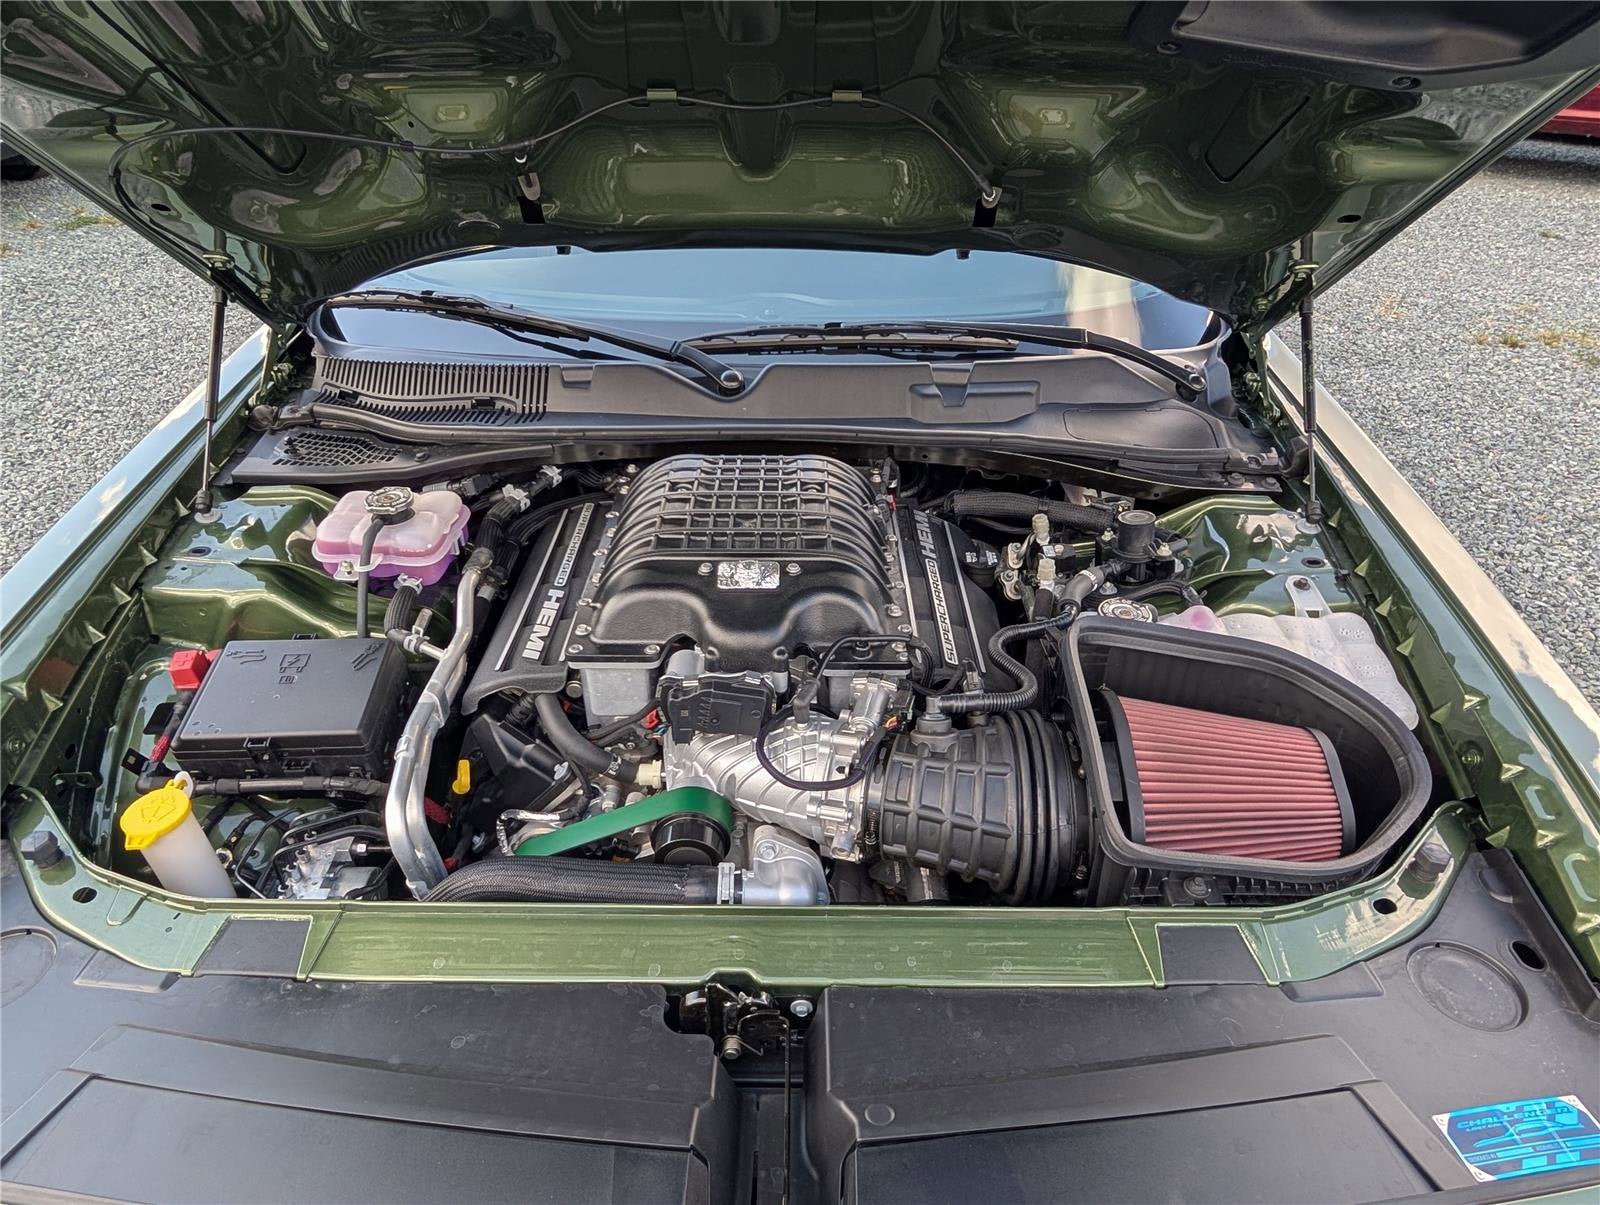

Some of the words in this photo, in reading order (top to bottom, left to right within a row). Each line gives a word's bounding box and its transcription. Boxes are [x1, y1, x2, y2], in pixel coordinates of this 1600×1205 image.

[555, 503, 594, 586] SUPERCHARGED
[913, 509, 937, 559] HEMI
[522, 588, 565, 661] HEMI
[926, 559, 959, 664] SUPERCHARGED
